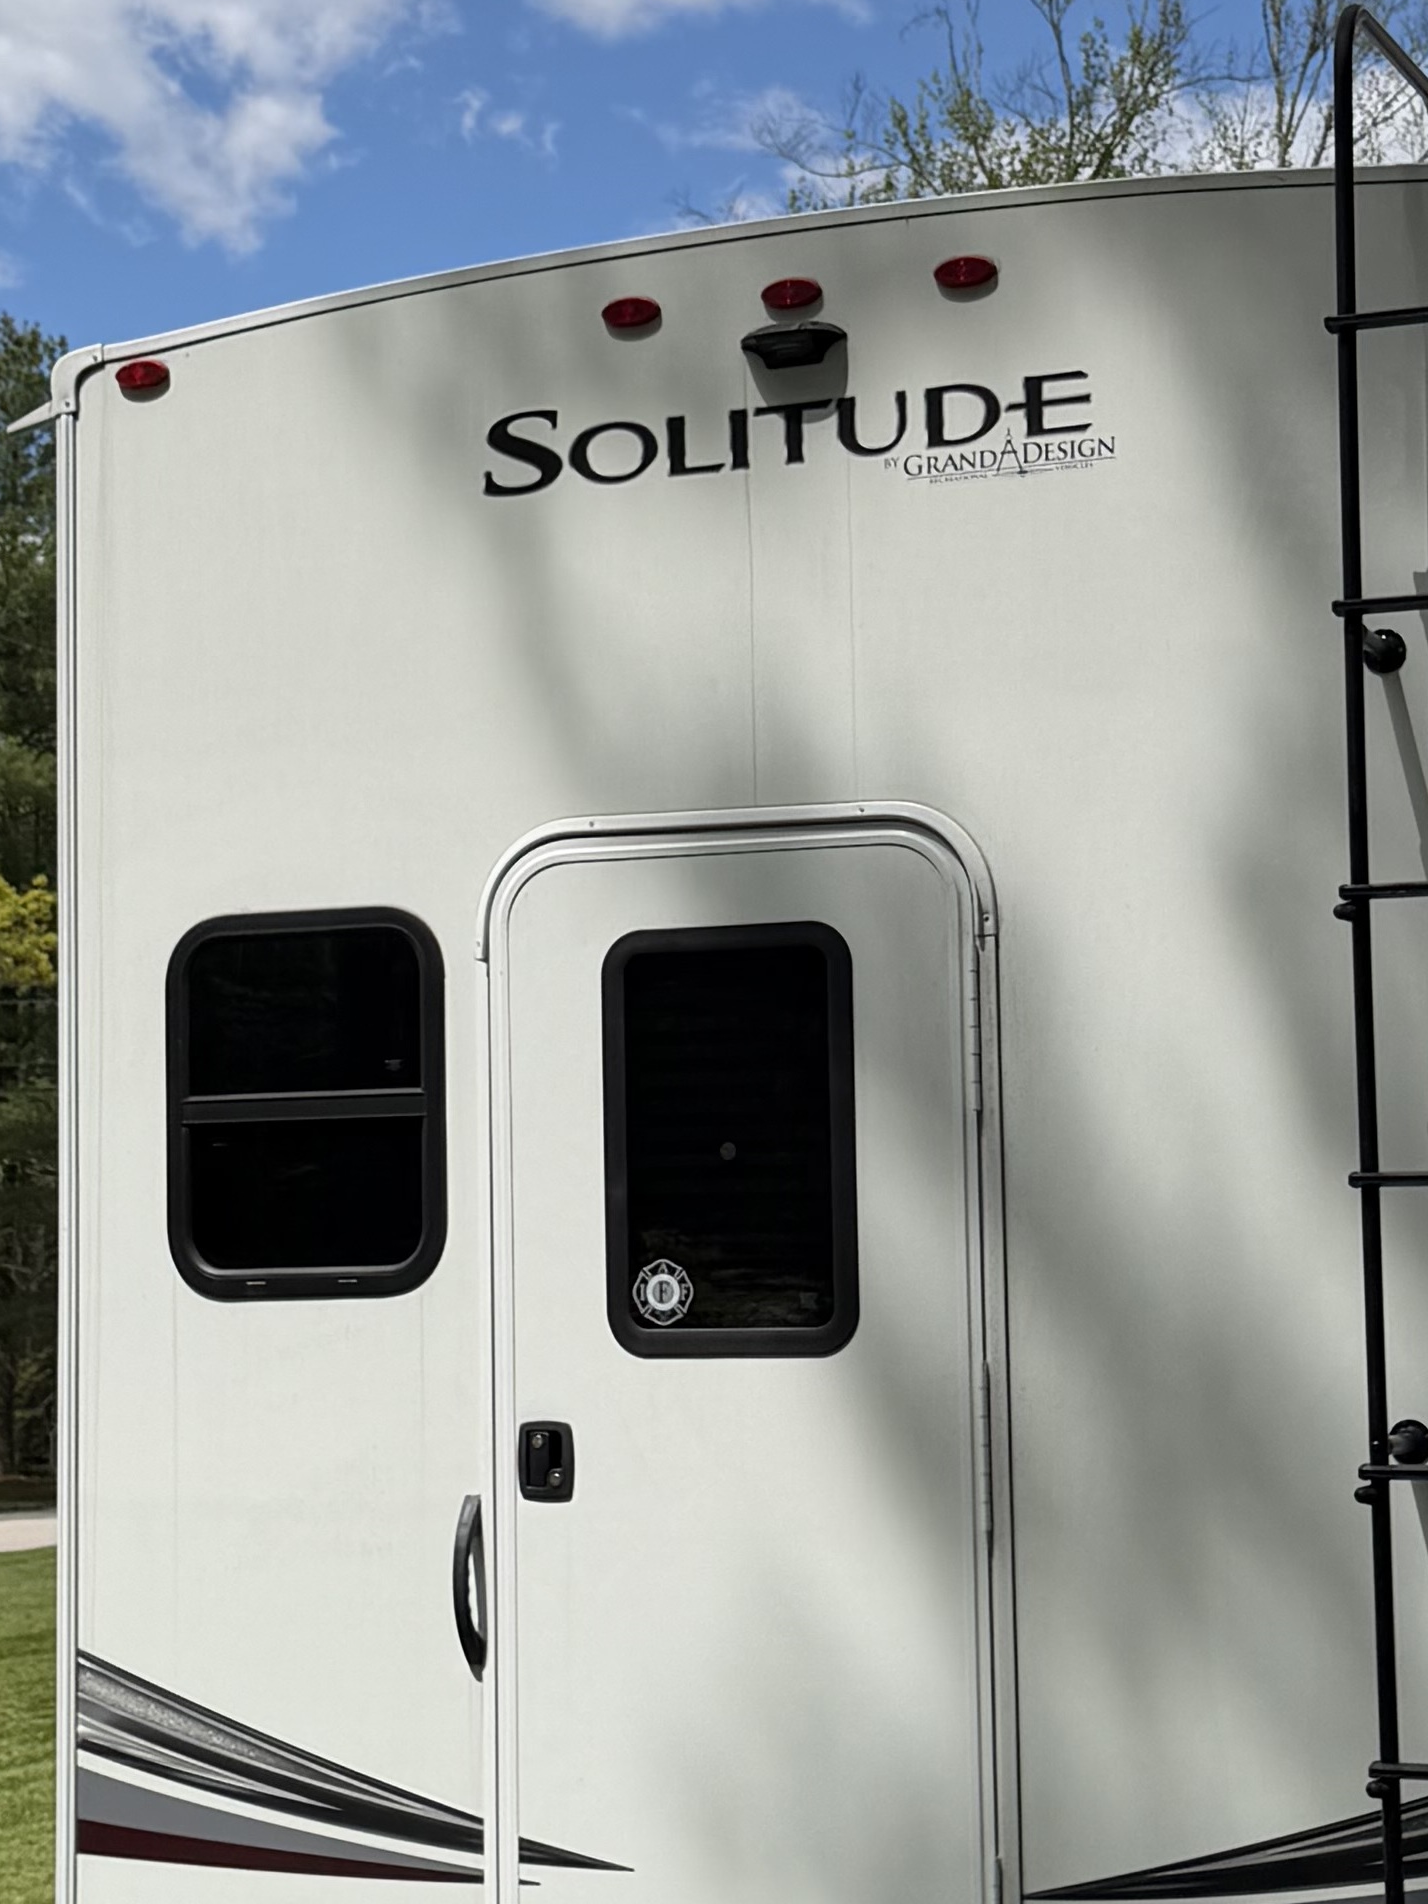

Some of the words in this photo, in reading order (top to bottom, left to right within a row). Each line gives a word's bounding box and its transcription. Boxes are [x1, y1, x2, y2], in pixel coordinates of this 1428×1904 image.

[482, 370, 1092, 497] SOLITUDE
[884, 456, 900, 470] BY
[903, 449, 997, 476] GRAND
[1022, 436, 1116, 464] DESIGN
